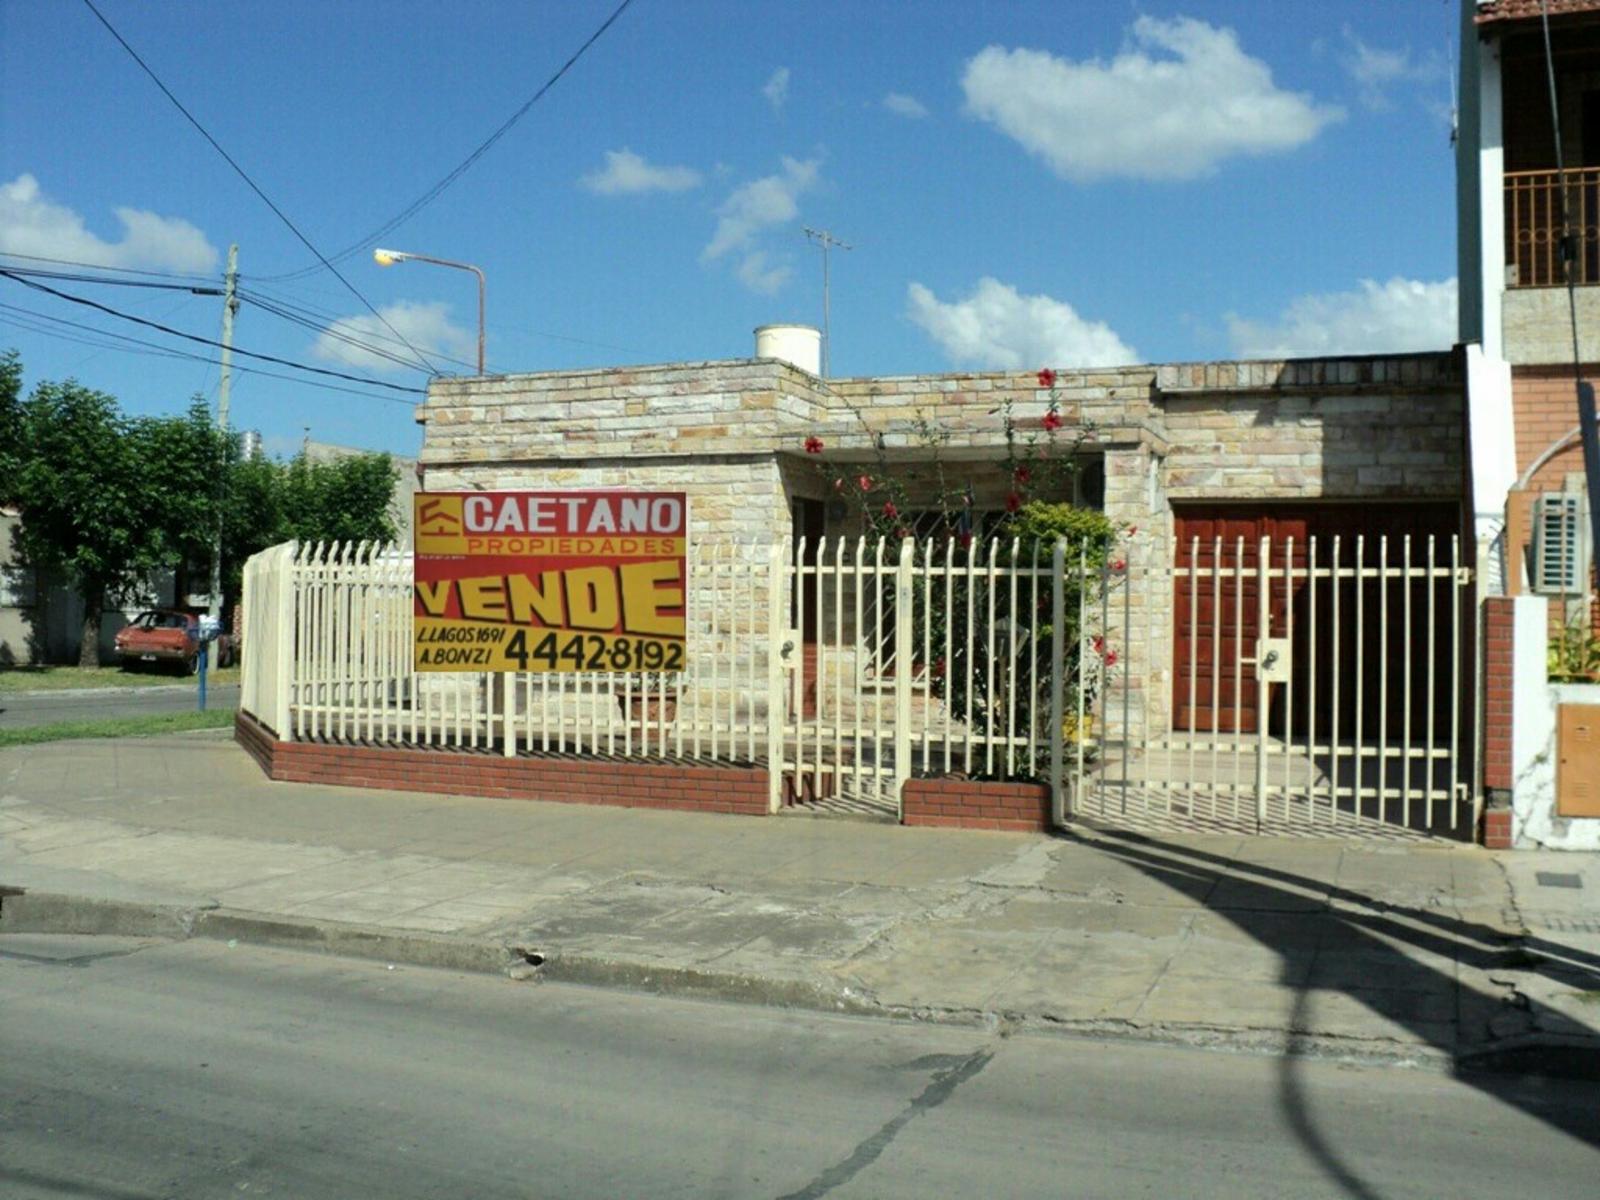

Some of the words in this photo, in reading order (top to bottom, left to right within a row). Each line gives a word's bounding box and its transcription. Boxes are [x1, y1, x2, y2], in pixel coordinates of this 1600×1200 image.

[463, 496, 681, 534] CAETANO
[467, 538, 675, 554] PROPIEDADES
[414, 560, 686, 639] VENDE
